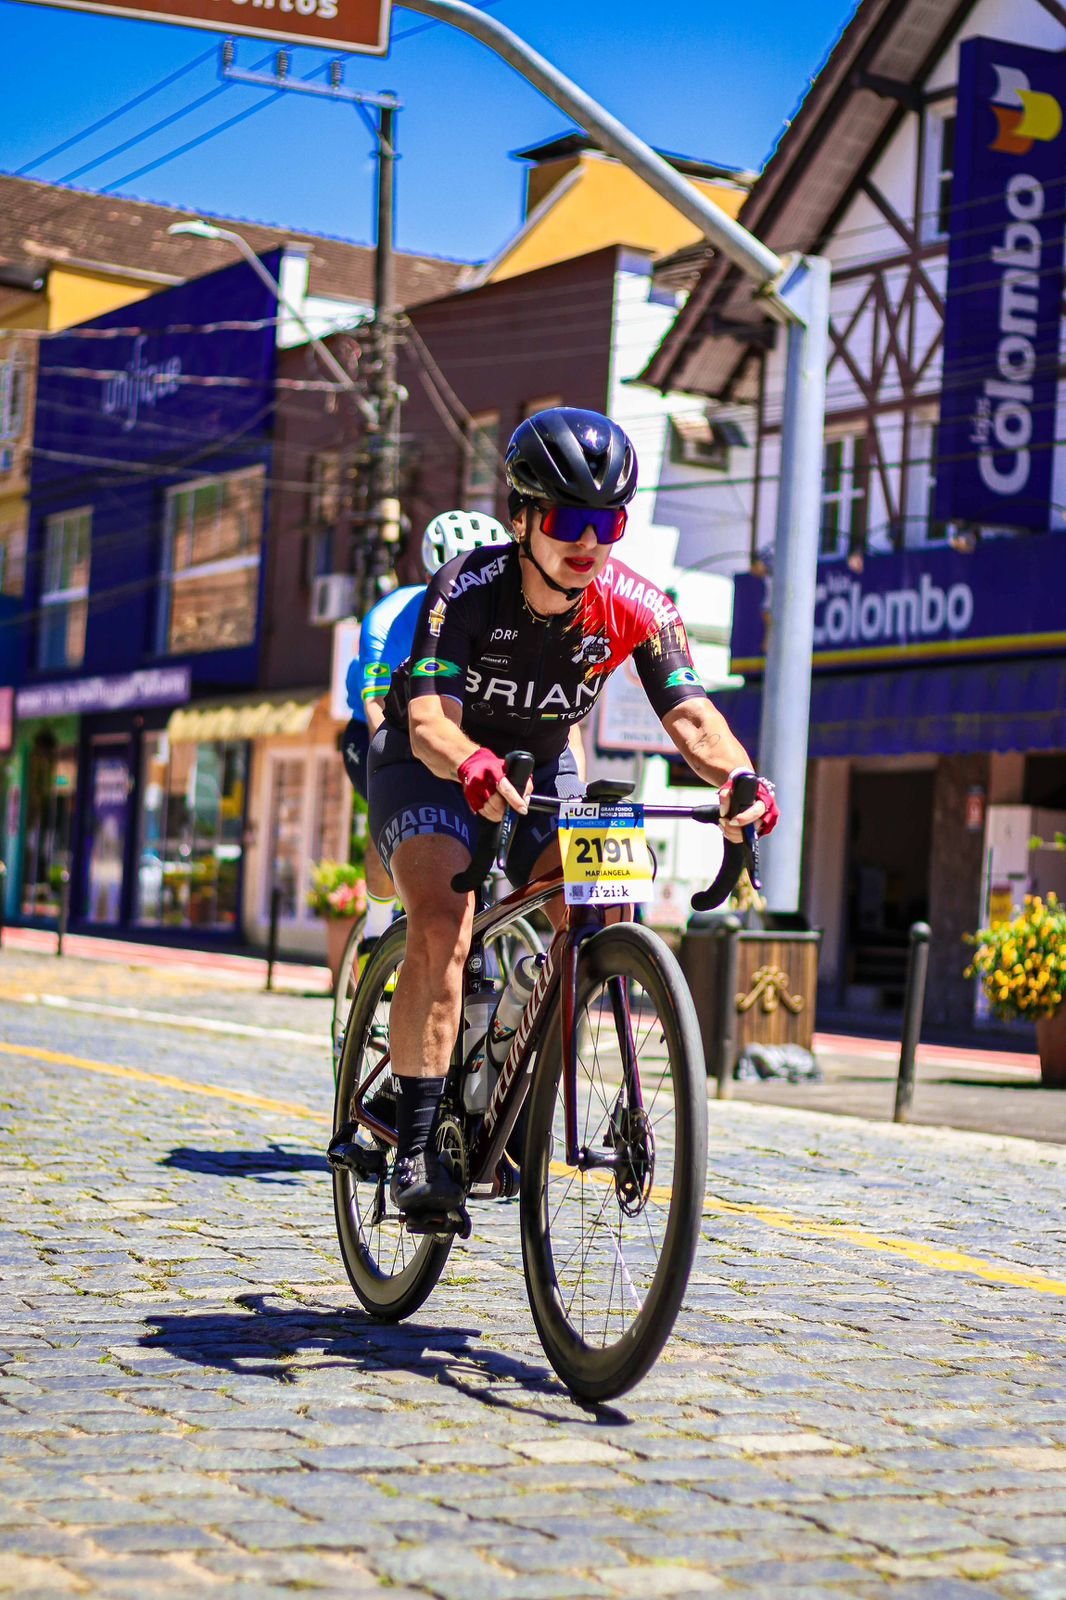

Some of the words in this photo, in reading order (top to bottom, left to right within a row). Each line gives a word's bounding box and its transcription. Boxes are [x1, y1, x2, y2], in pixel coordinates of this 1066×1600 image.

[978, 173, 1046, 496] Colombo
[560, 702, 593, 720] TEAM
[574, 807, 597, 817] UCI
[385, 807, 470, 846] MAGLIA
[574, 837, 634, 863] 2191
